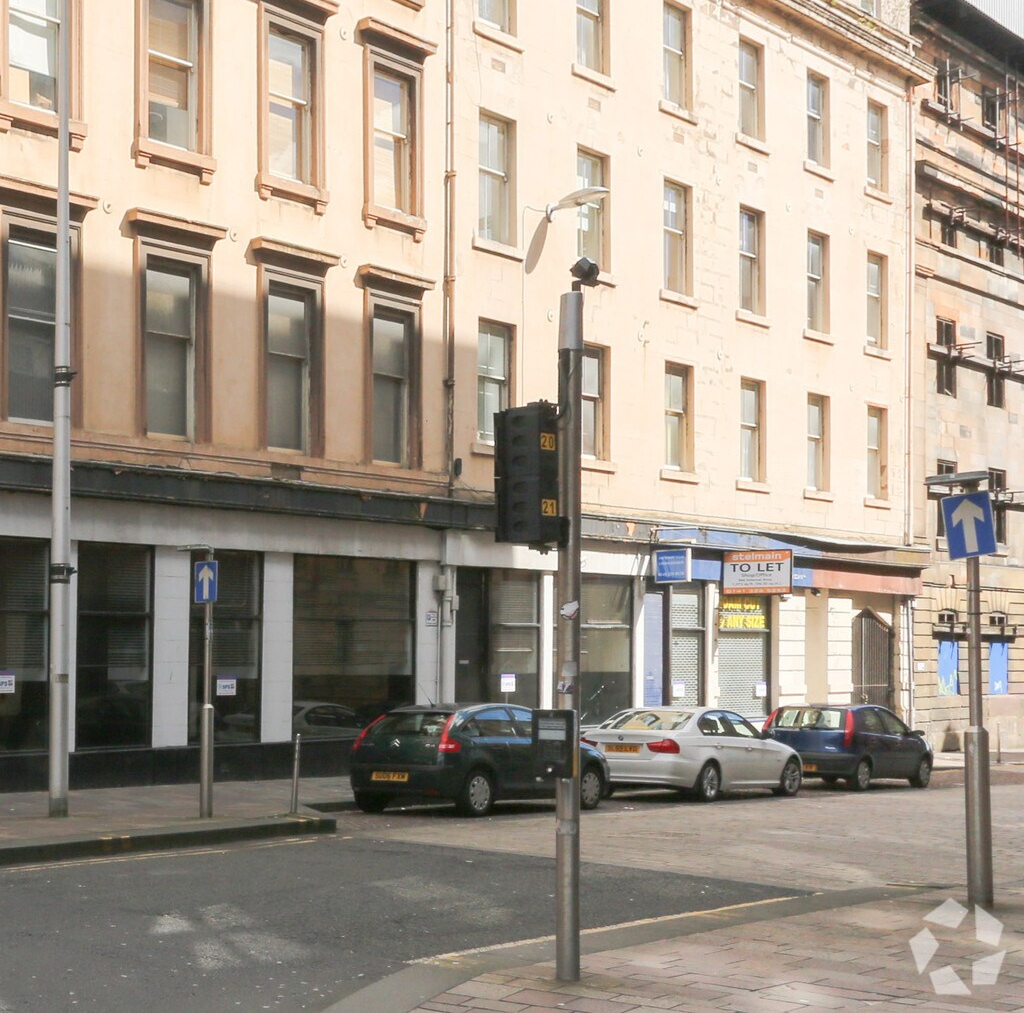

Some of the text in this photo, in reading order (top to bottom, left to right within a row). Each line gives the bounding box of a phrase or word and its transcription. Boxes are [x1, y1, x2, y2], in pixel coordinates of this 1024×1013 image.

[541, 435, 554, 448] 20
[542, 500, 555, 515] 21
[732, 552, 782, 561] stelmain
[730, 562, 784, 572] TO LET
[745, 615, 765, 629] SIZE
